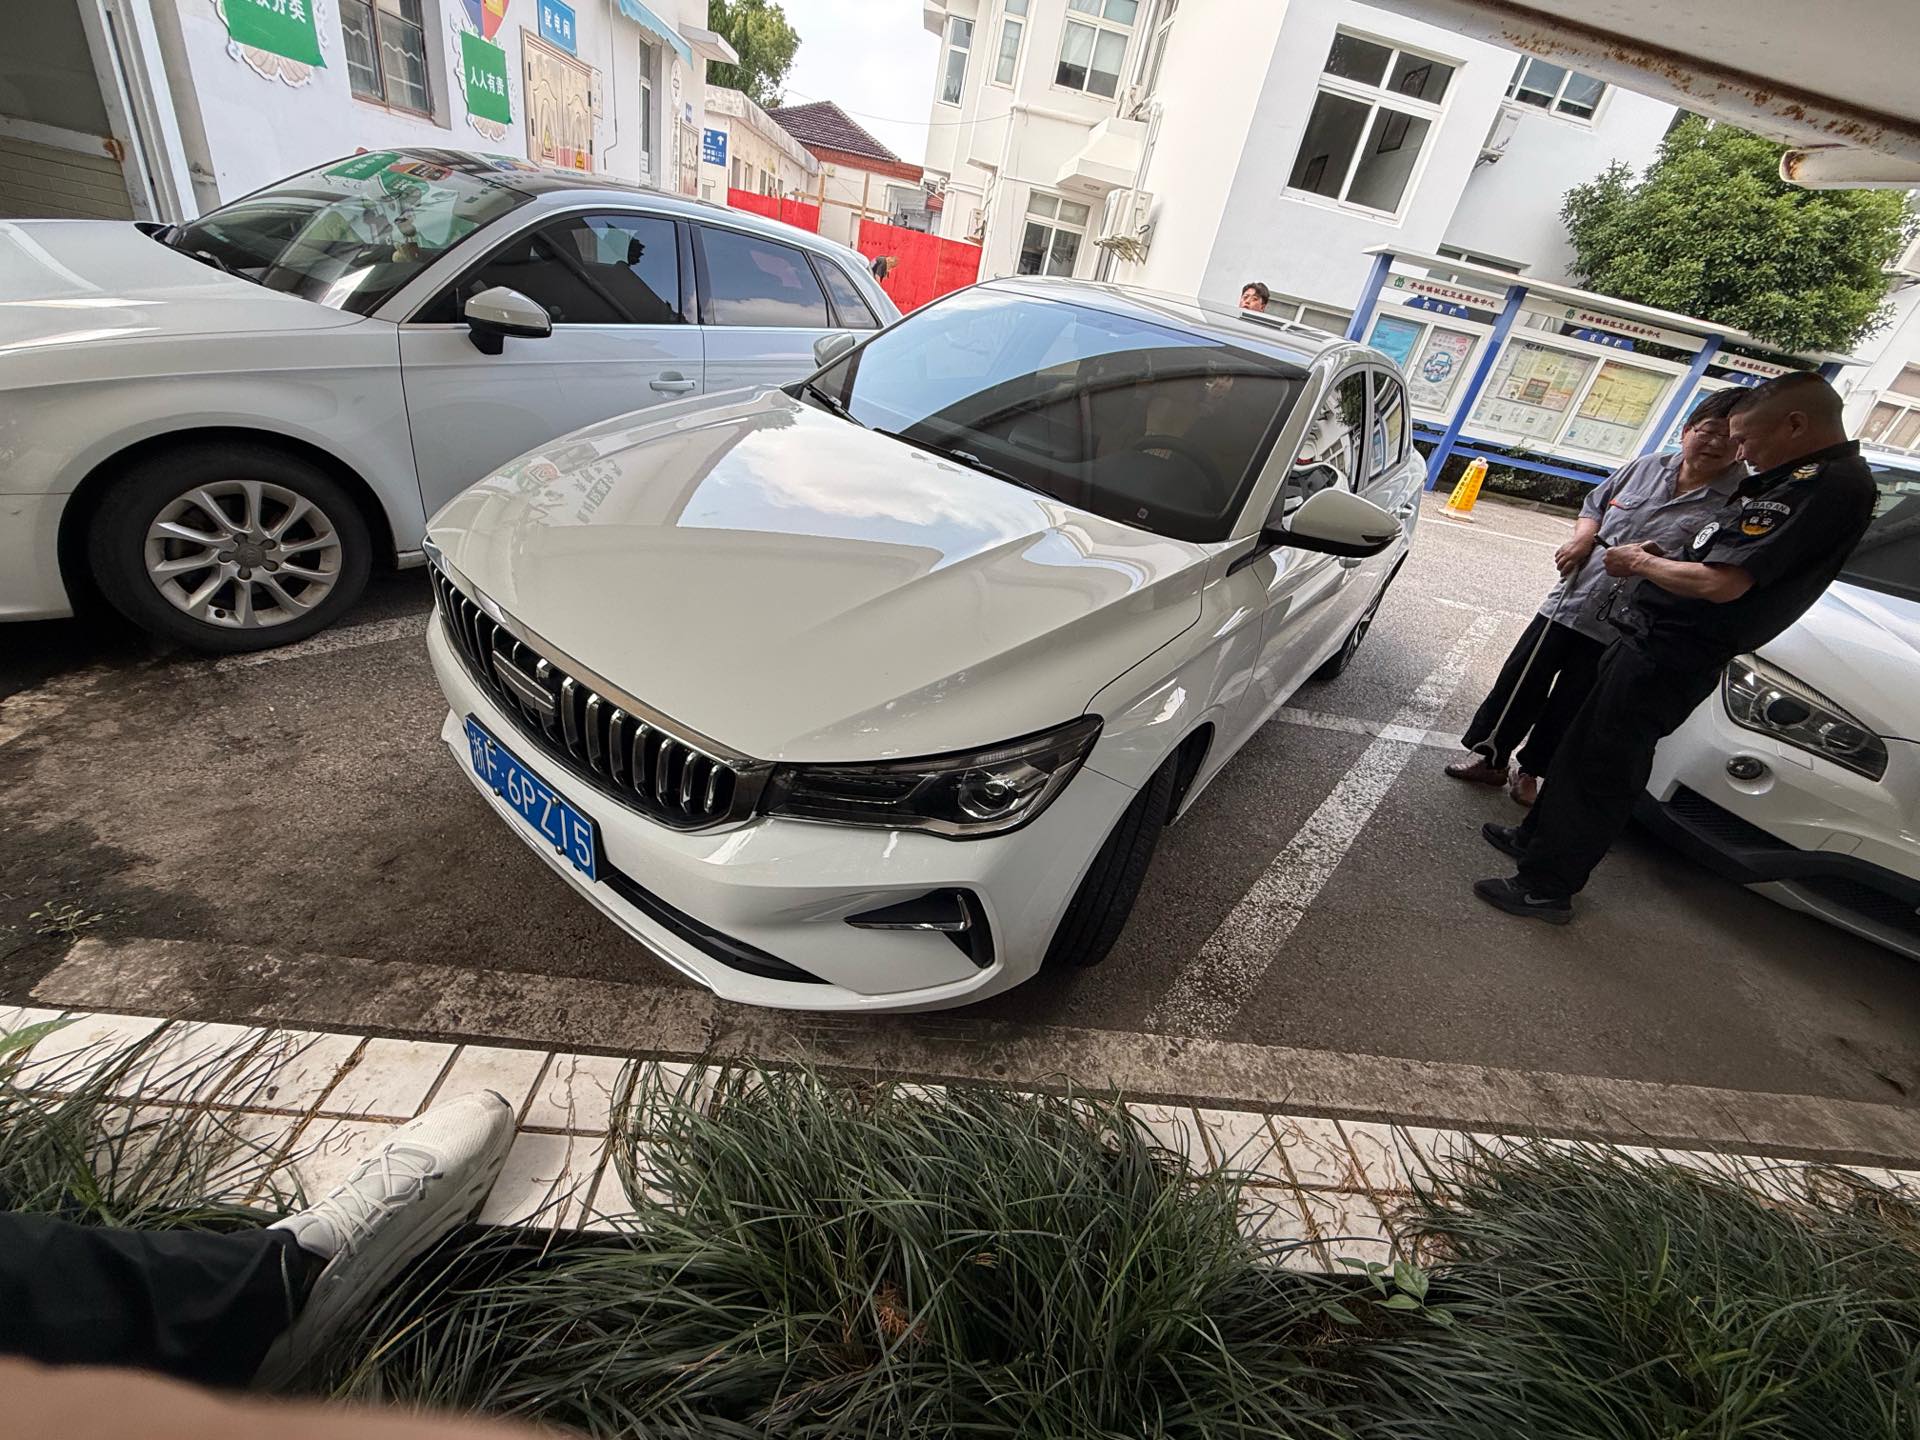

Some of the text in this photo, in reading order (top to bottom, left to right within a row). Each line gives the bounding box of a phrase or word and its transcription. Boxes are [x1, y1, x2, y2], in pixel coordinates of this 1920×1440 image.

[543, 5, 571, 40] 配电间
[470, 65, 505, 97] 人人有责
[1749, 515, 1774, 526] 保安
